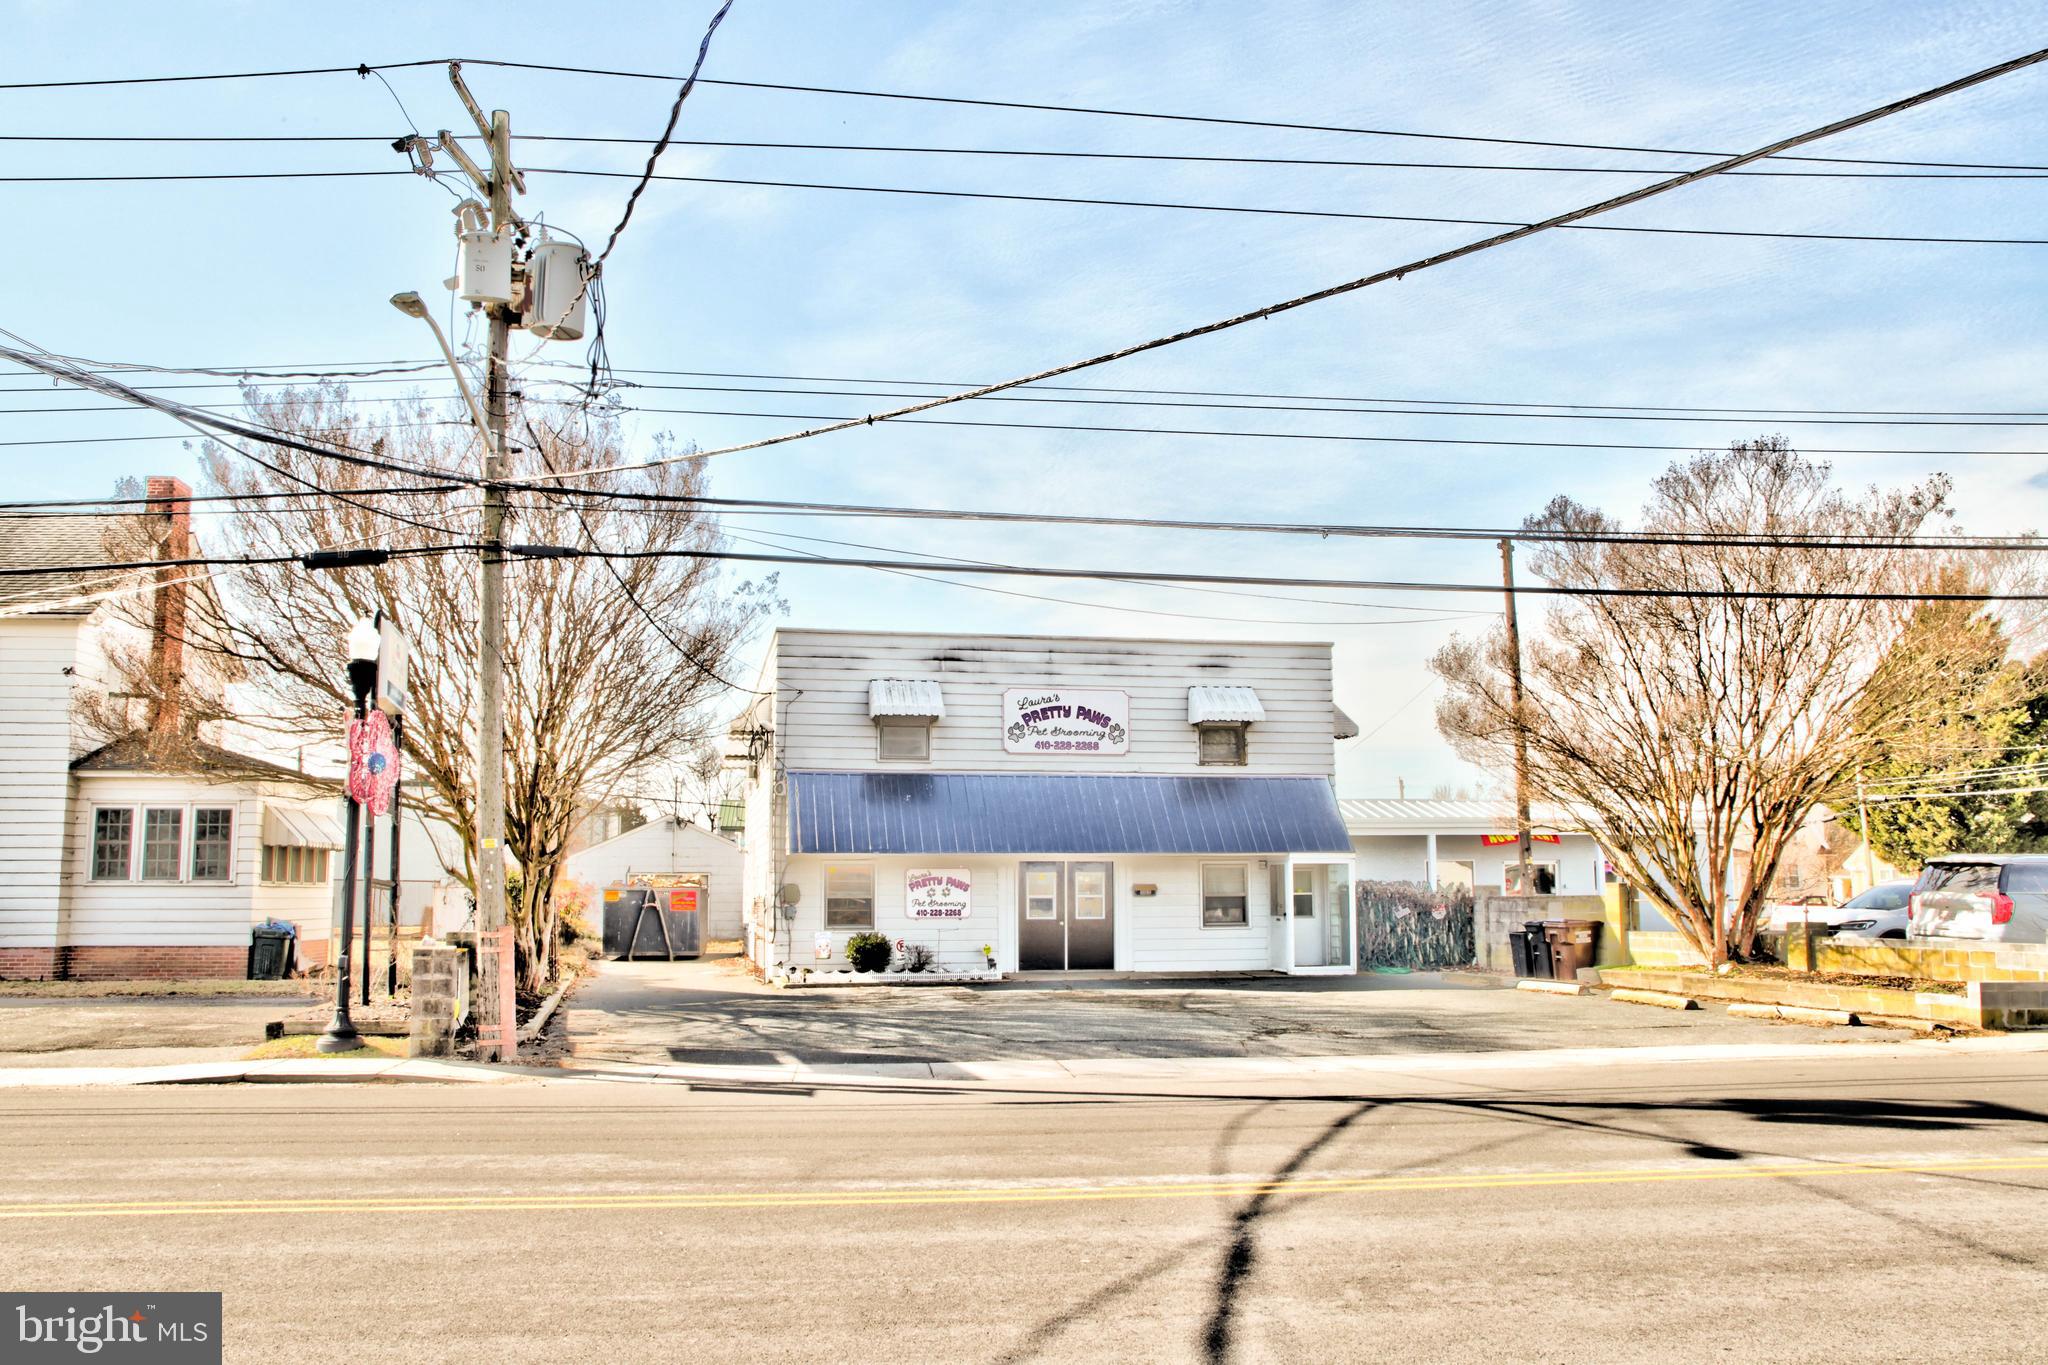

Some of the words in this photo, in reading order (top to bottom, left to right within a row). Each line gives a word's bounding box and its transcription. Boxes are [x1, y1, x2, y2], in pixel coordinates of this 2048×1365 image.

[1017, 693, 1061, 711] Laura's
[1020, 705, 1072, 727] PRETTY
[1076, 705, 1112, 729] PAWS
[1027, 725, 1048, 737] Pet
[1050, 726, 1106, 741] Grooming
[1034, 740, 1100, 751] 410-228-2268
[908, 876, 943, 892] PRETTY
[946, 876, 970, 892] PAWS
[912, 899, 927, 907] Pet
[928, 899, 967, 909] Grooming
[916, 909, 962, 917] 410-228-2268
